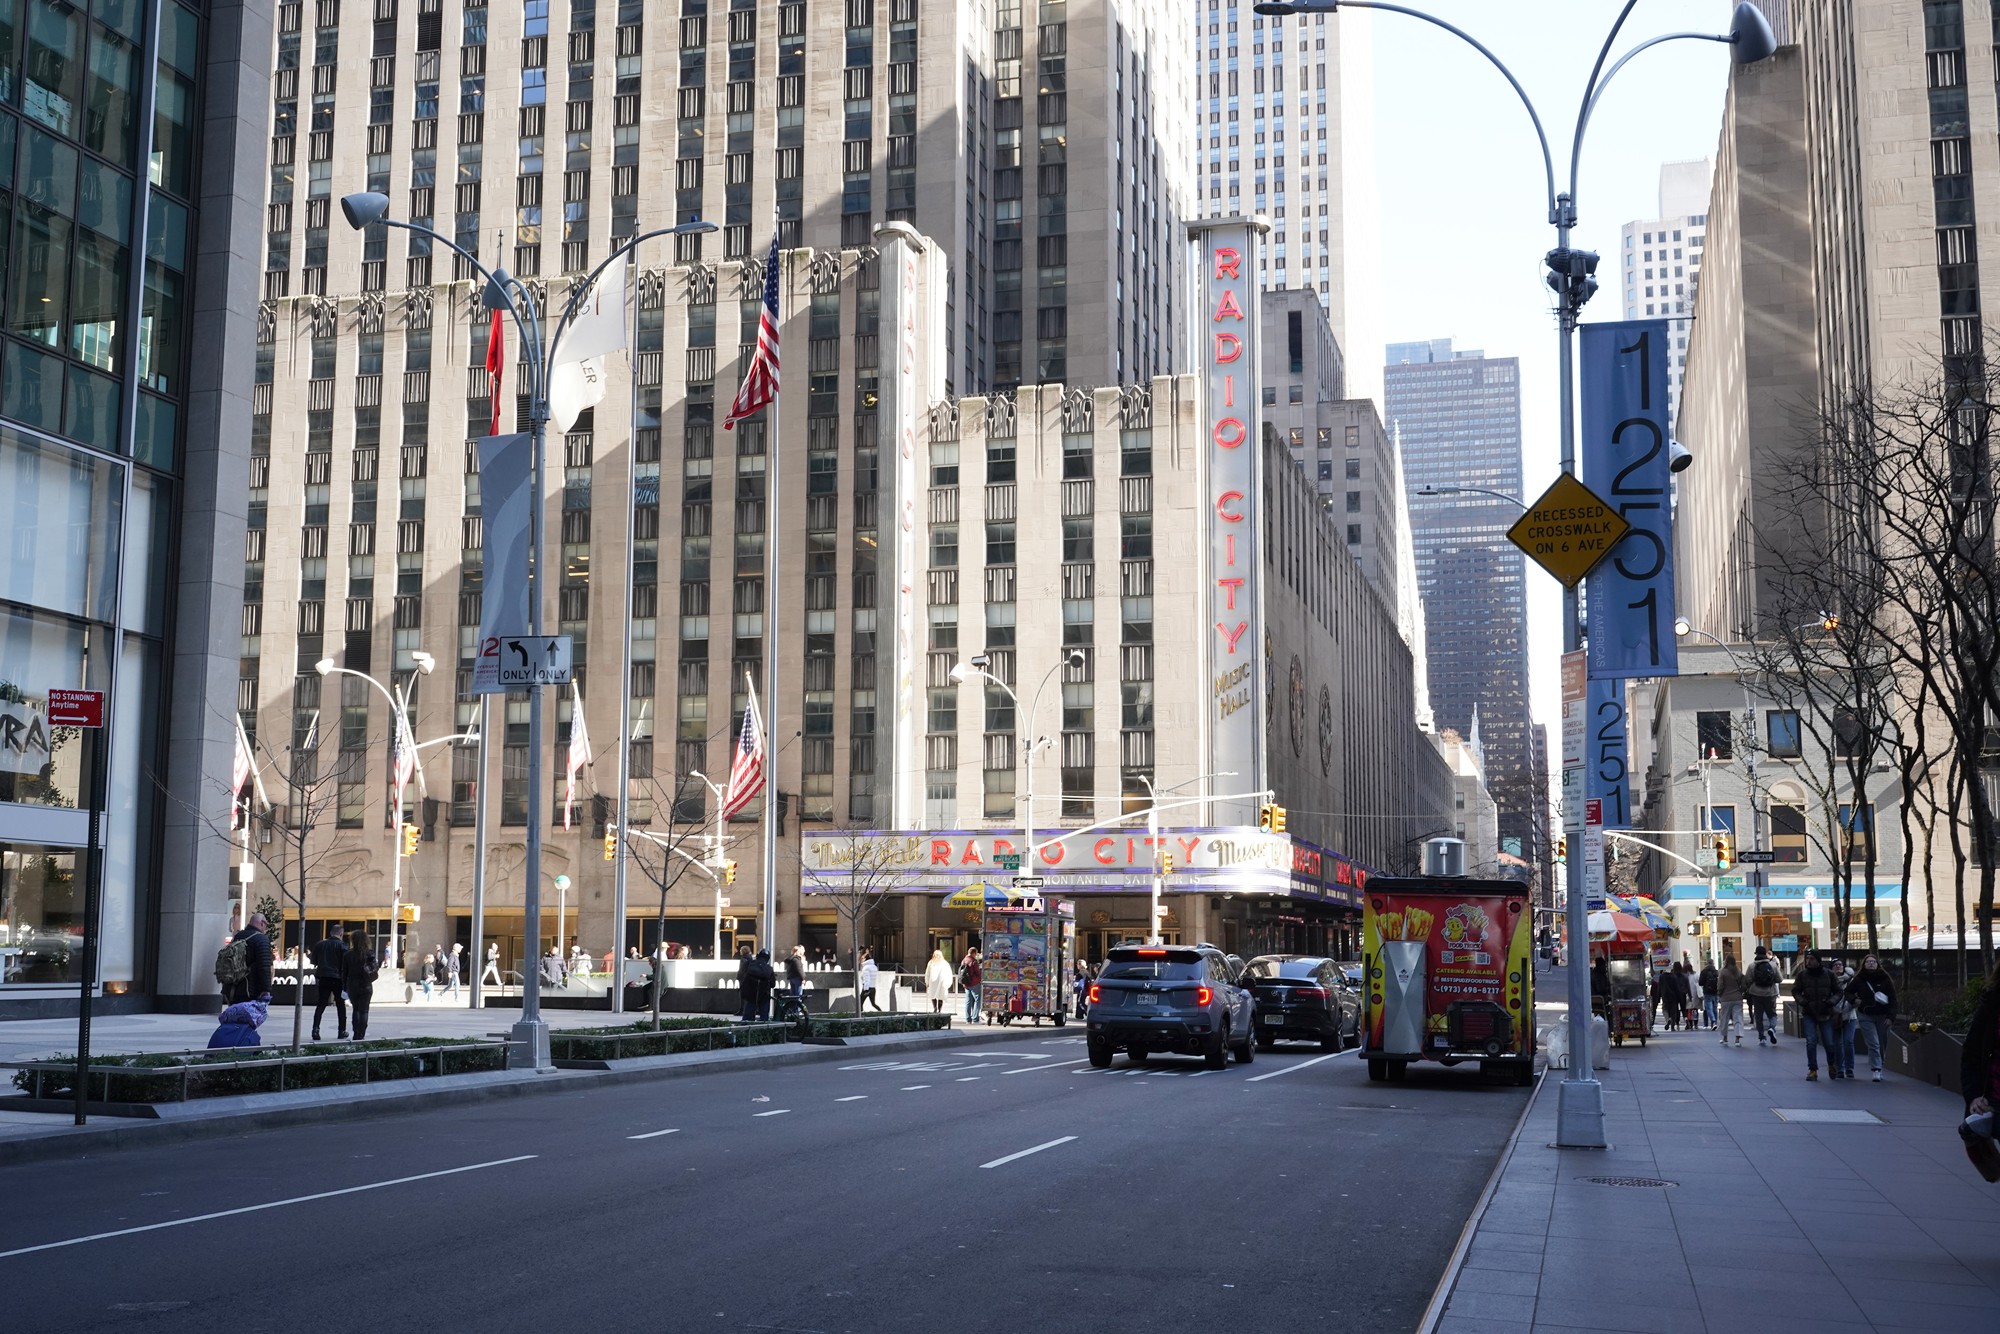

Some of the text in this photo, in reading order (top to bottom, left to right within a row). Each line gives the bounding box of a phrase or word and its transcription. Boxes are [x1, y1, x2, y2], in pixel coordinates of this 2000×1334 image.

[1213, 247, 1248, 654] RADIO CITY
[1610, 331, 1666, 666] 1251
[1533, 506, 1604, 522] RECESSED
[1528, 522, 1611, 539] CROSSWALK
[1536, 538, 1605, 554] ON 6 AVE
[1593, 574, 1606, 667] OF THE AMERICAS
[503, 670, 530, 680] ONLY
[538, 669, 566, 680] ONLY
[1215, 662, 1250, 698] MUSIC
[51, 692, 95, 702] NO STANDING
[1220, 687, 1250, 720] HALL
[51, 701, 80, 710] Anytime
[1563, 704, 1568, 718] 3
[0, 713, 49, 753] RA
[1563, 771, 1569, 785] 5
[931, 838, 1066, 866] RADO
[1094, 837, 1201, 865] CITY
[928, 876, 951, 885] APR
[958, 876, 965, 885] 6
[981, 875, 1013, 886] RICA
[1043, 875, 1108, 885] MONTANER
[1124, 875, 1147, 885] SAT
[1161, 875, 1183, 885] APR
[1189, 875, 1201, 884] 15
[1733, 887, 1836, 896] WABY PAER
[1440, 985, 1500, 994] (973) 498-8717
